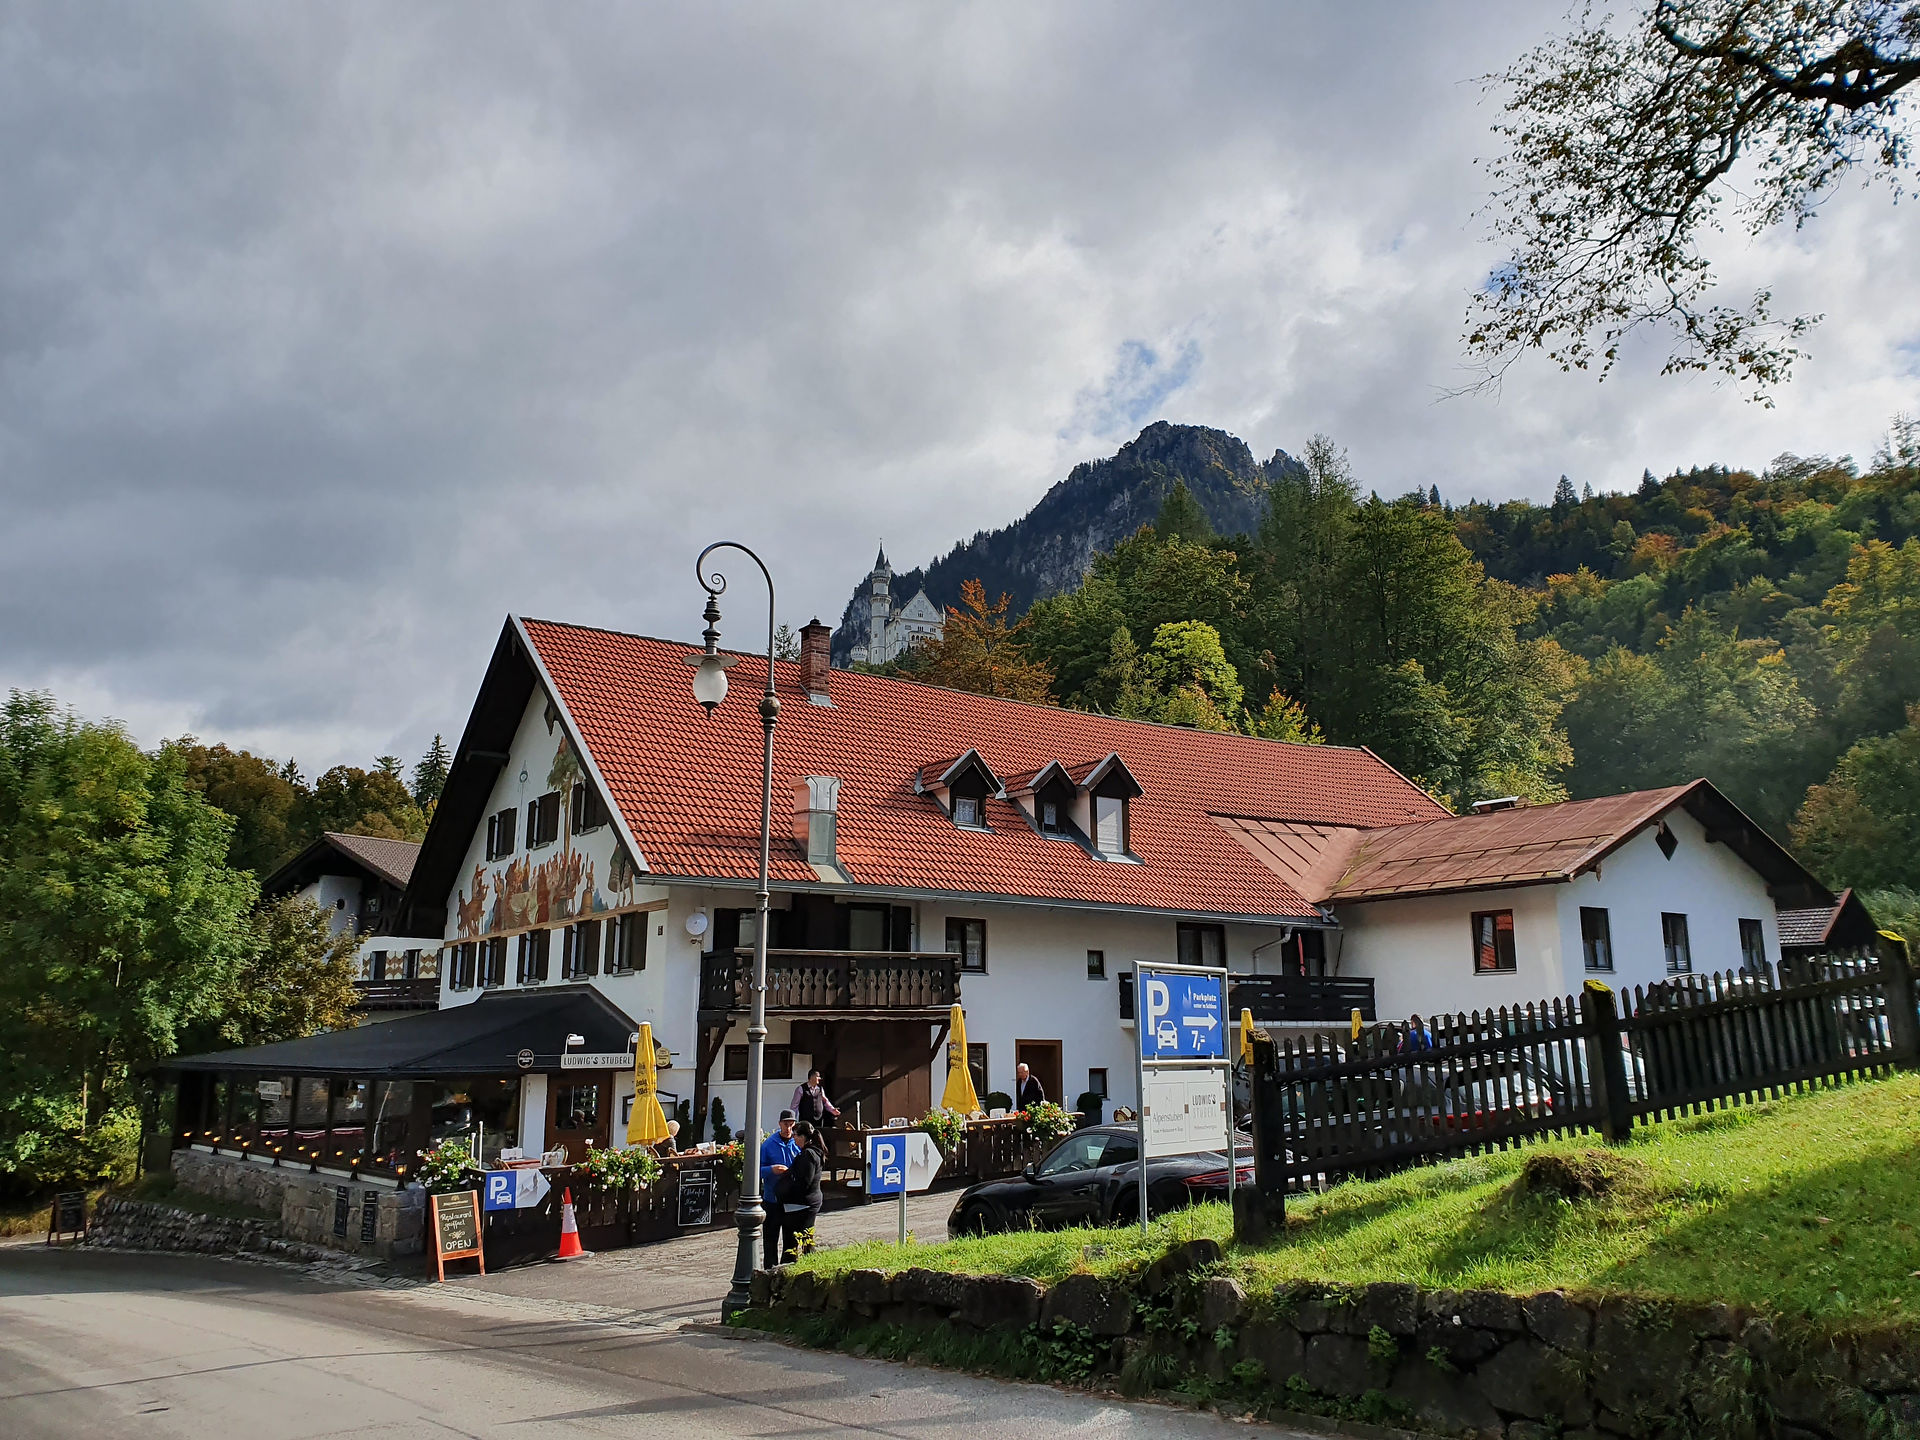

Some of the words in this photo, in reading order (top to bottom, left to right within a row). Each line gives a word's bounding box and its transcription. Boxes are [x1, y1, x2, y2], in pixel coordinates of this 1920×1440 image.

[1147, 980, 1170, 1035] P
[563, 1056, 599, 1065] LUDWIG'S
[1192, 1093, 1217, 1106] LUDWIG'S
[877, 1143, 896, 1178] P
[490, 1176, 508, 1200] P
[445, 1239, 472, 1250] OPEN
